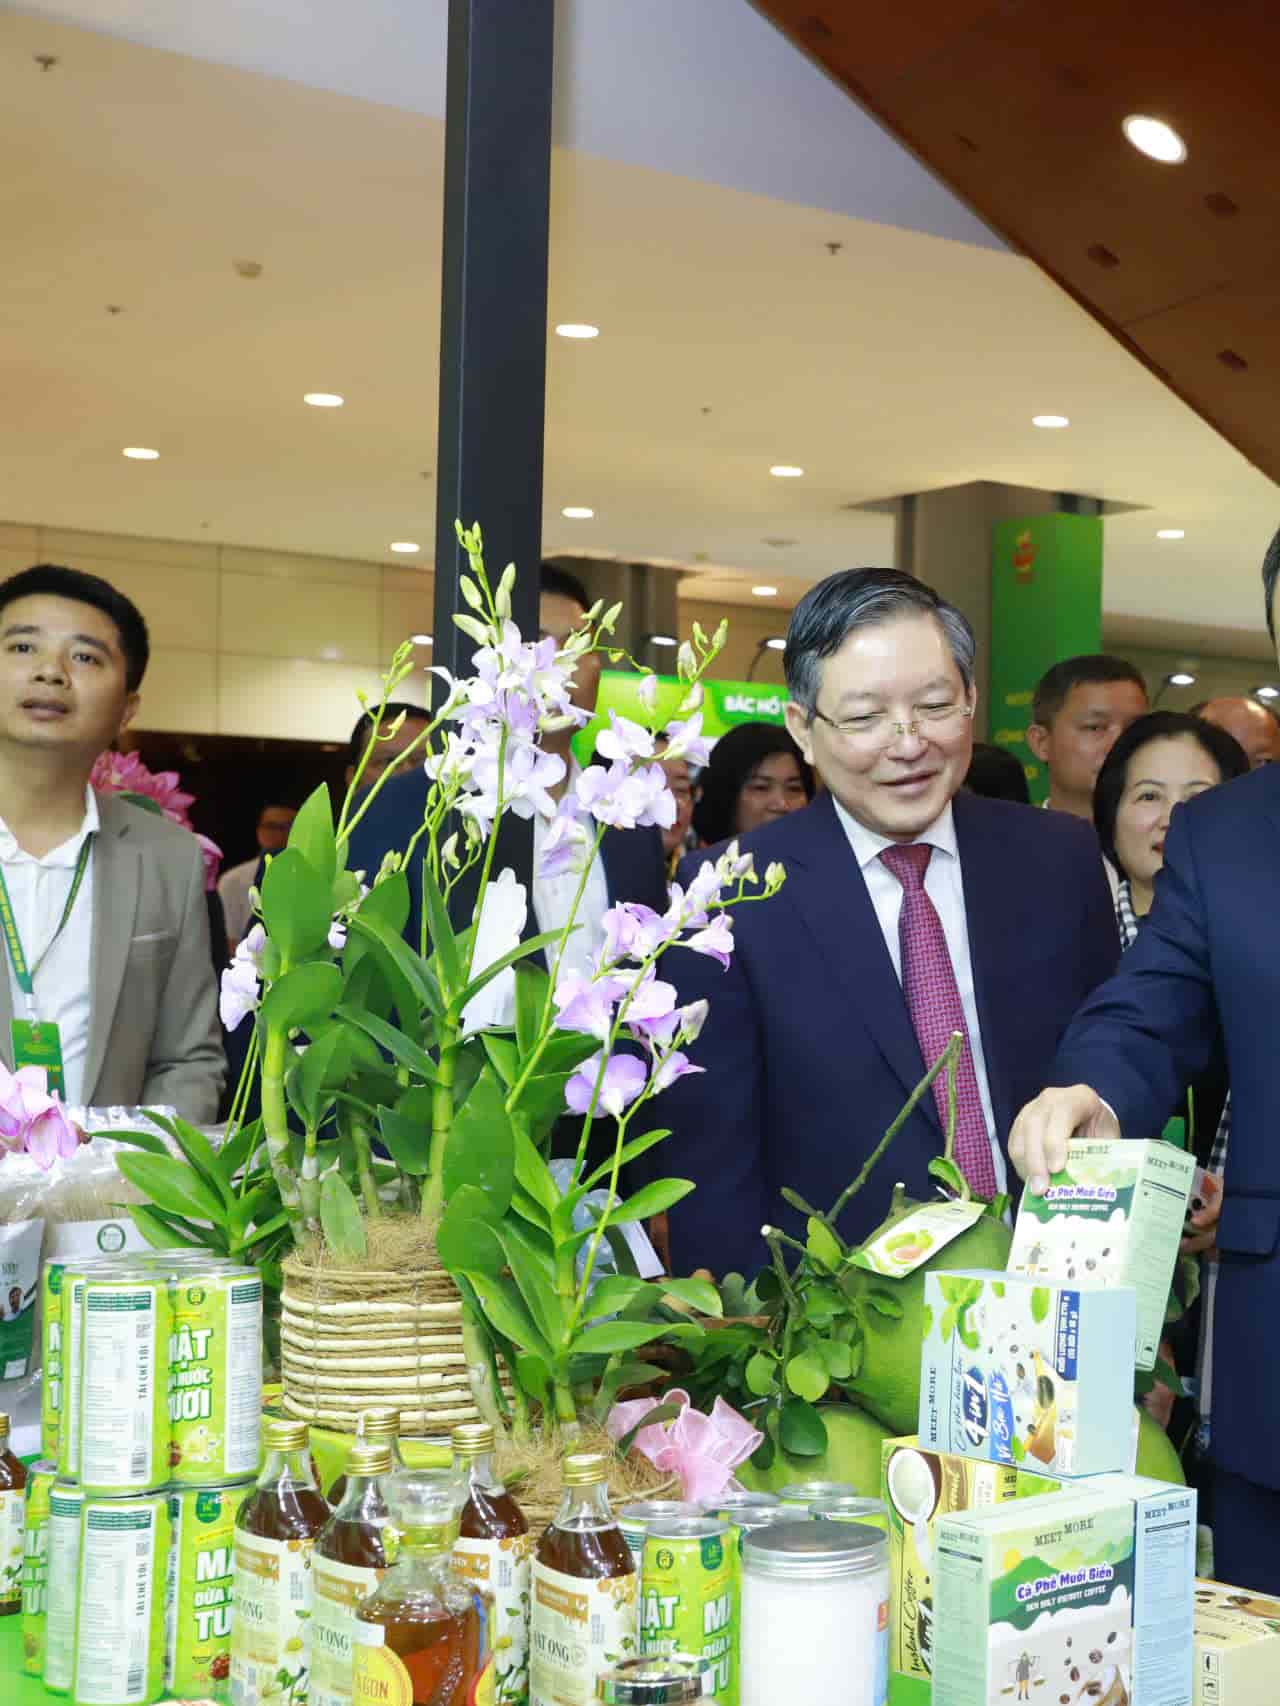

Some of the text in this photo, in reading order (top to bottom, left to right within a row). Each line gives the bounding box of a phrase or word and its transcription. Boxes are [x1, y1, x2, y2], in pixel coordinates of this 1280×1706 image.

[929, 1367, 937, 1405] MORE
[1034, 1517, 1095, 1546] MEET MORE
[1017, 1584, 1032, 1600] Cà
[1035, 1577, 1057, 1592] Phê
